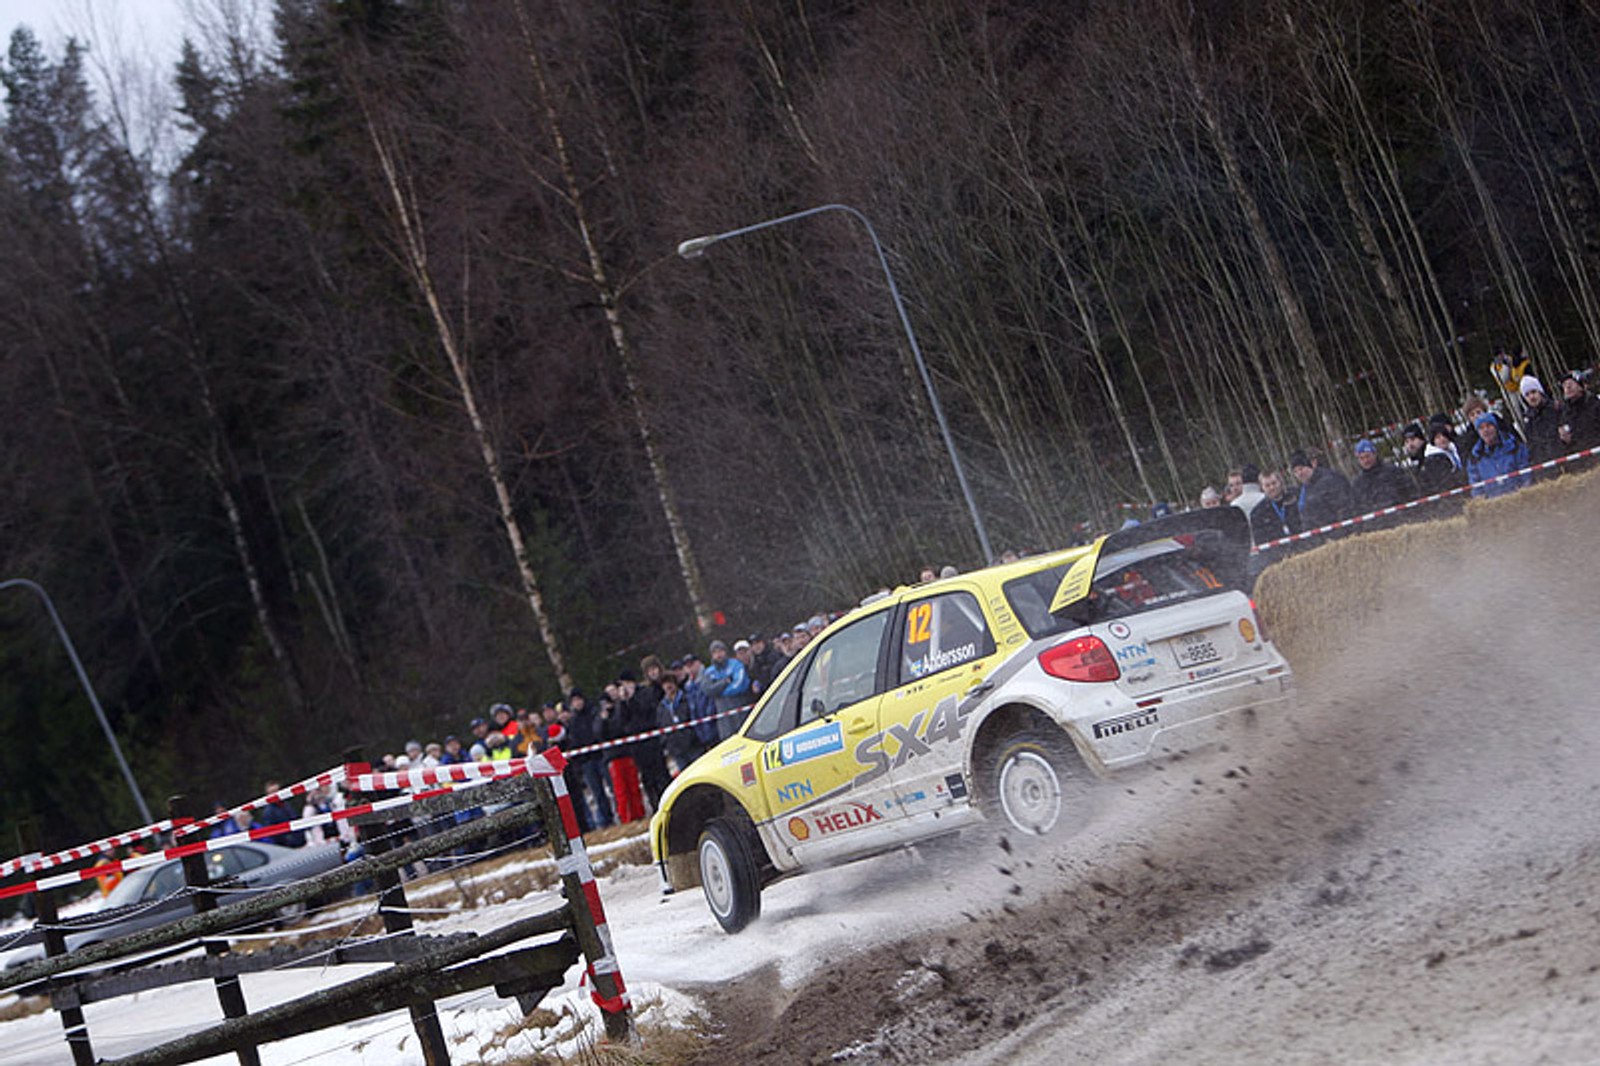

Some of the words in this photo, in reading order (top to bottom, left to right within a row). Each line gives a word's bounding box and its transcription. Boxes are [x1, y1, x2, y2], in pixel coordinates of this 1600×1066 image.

[907, 602, 932, 645] 12
[922, 643, 976, 674] Andersson
[1116, 641, 1148, 660] NTN
[1092, 707, 1160, 739] PIRELLI
[853, 693, 969, 789] SX4
[777, 778, 814, 803] NTN
[815, 803, 881, 834] HELIX
